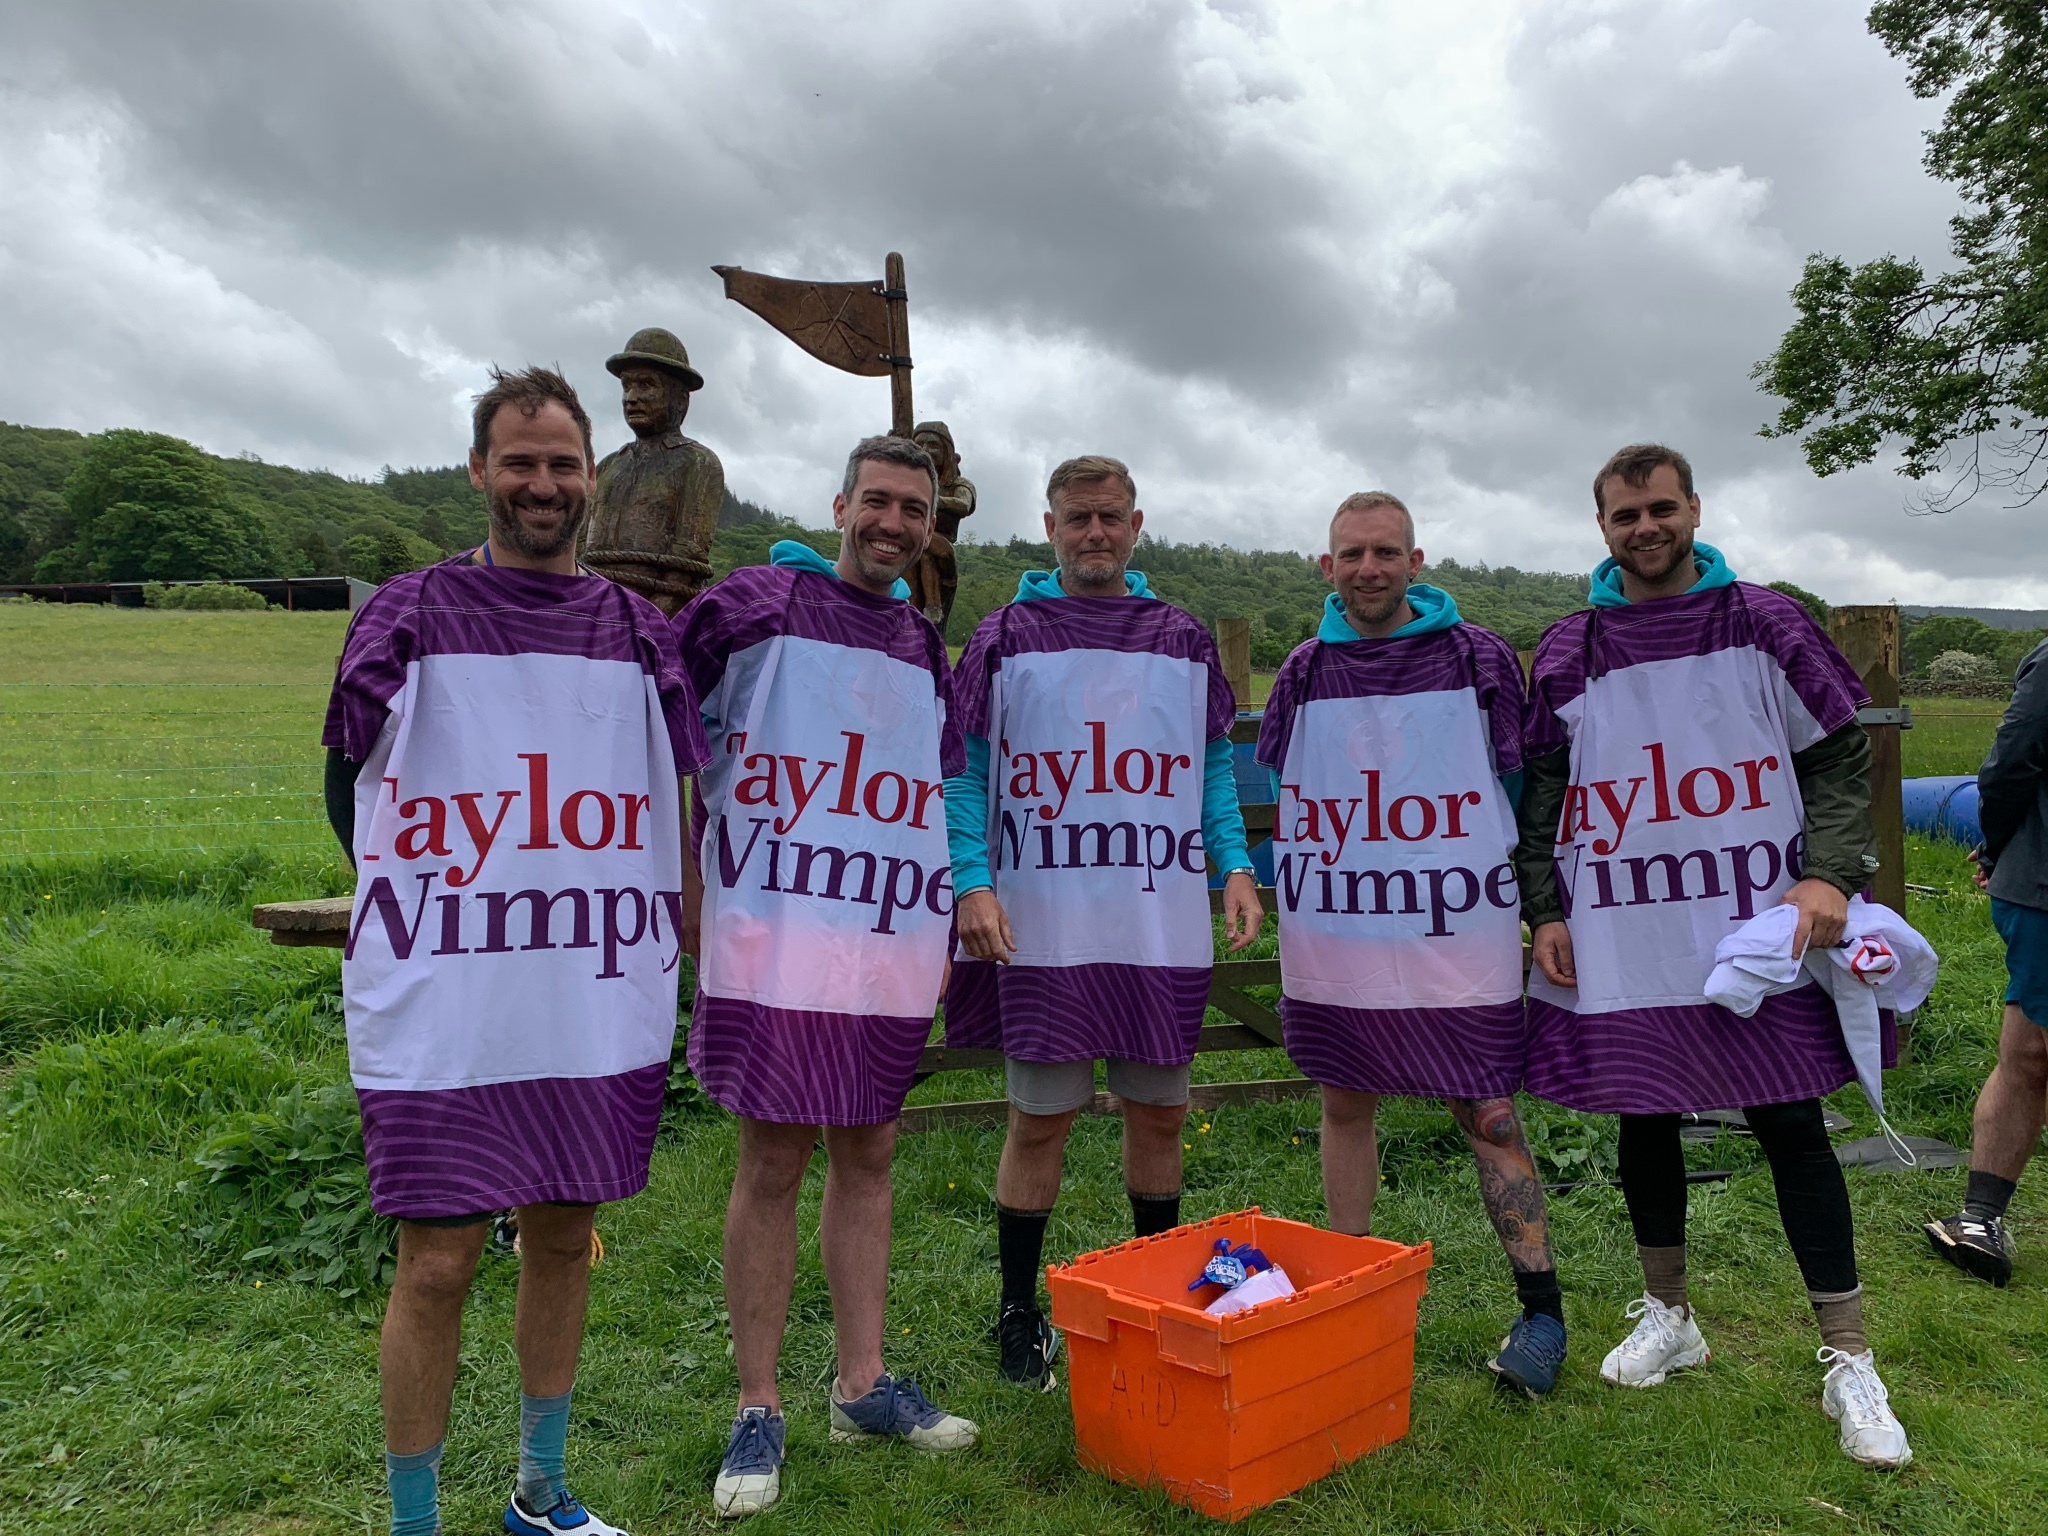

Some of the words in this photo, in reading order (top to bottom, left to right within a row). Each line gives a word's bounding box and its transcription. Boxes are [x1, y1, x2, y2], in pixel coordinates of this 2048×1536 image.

[1000, 720, 1191, 820] aylor
[344, 871, 682, 980] Wimpy
[1110, 1368, 1177, 1428] AID
